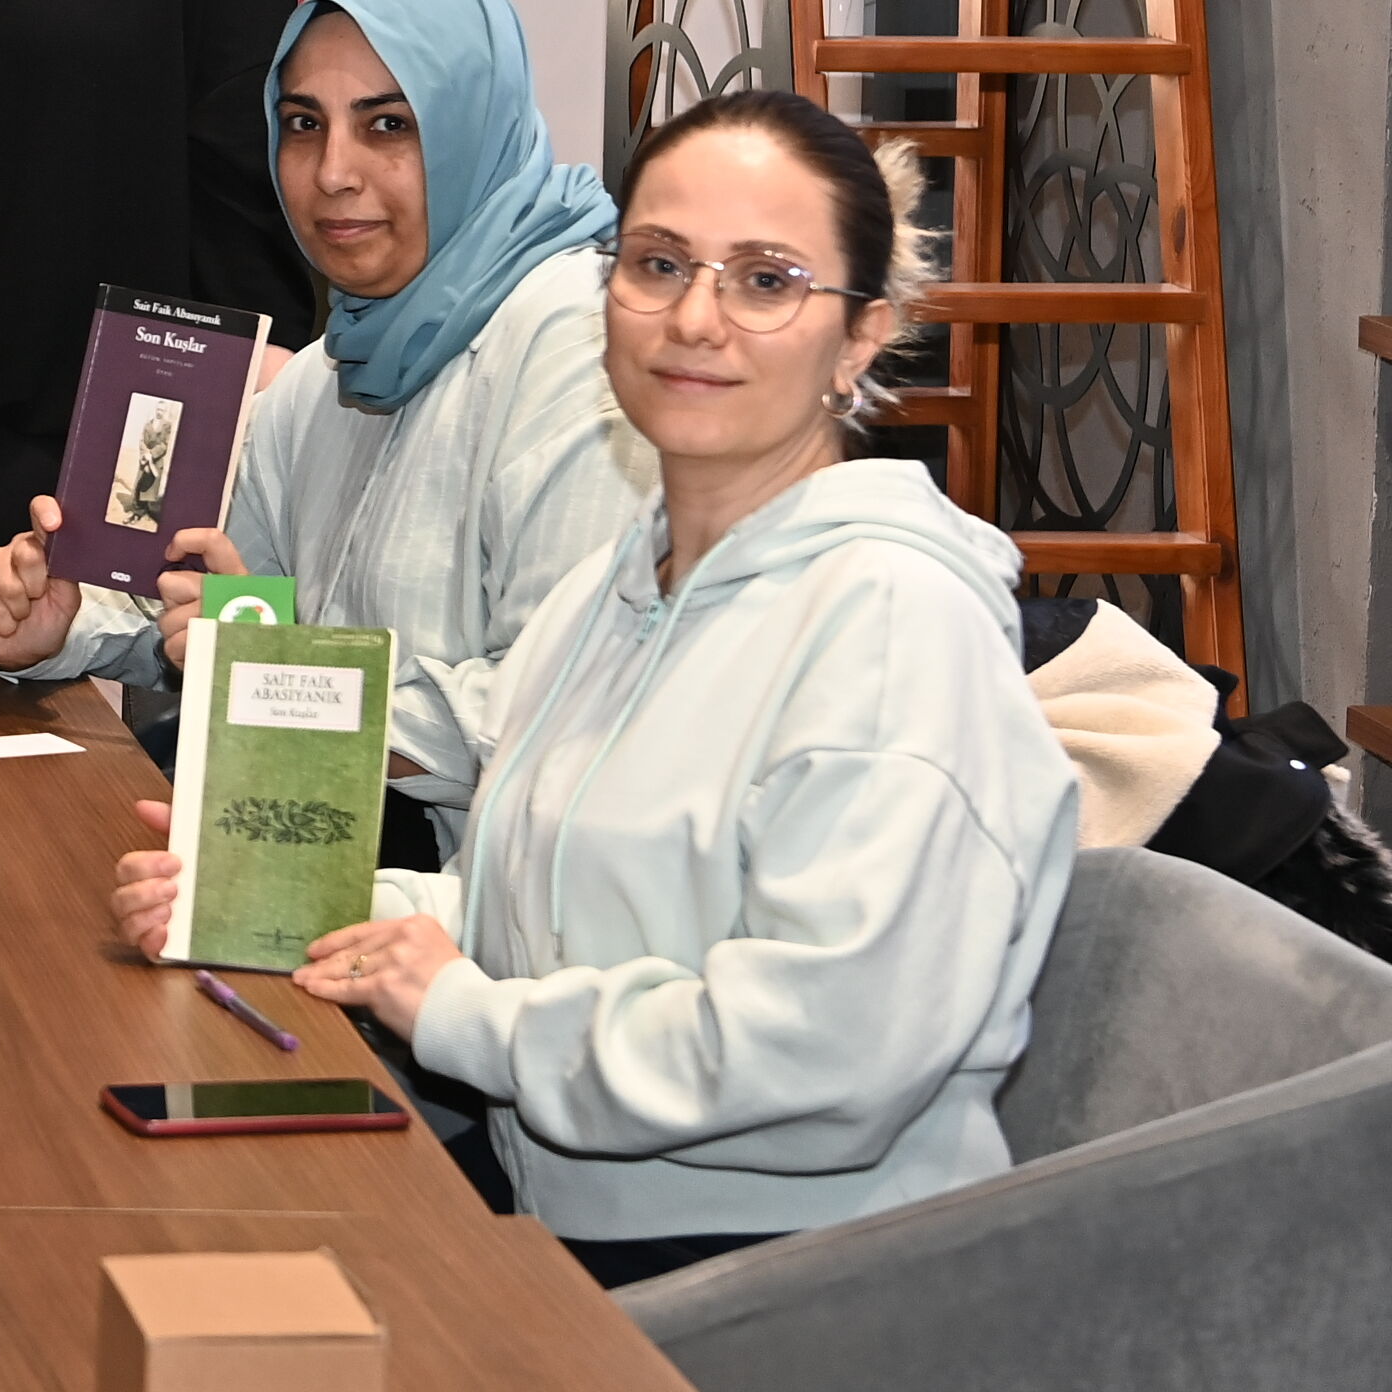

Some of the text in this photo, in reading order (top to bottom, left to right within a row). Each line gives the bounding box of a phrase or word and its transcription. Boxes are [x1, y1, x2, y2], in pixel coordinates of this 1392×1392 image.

[133, 298, 151, 312] Sait
[152, 302, 171, 316] Faik
[135, 326, 208, 353] Son Kuşlar
[262, 672, 332, 689] SAİT FAİK
[251, 688, 341, 704] ABASIYANIK
